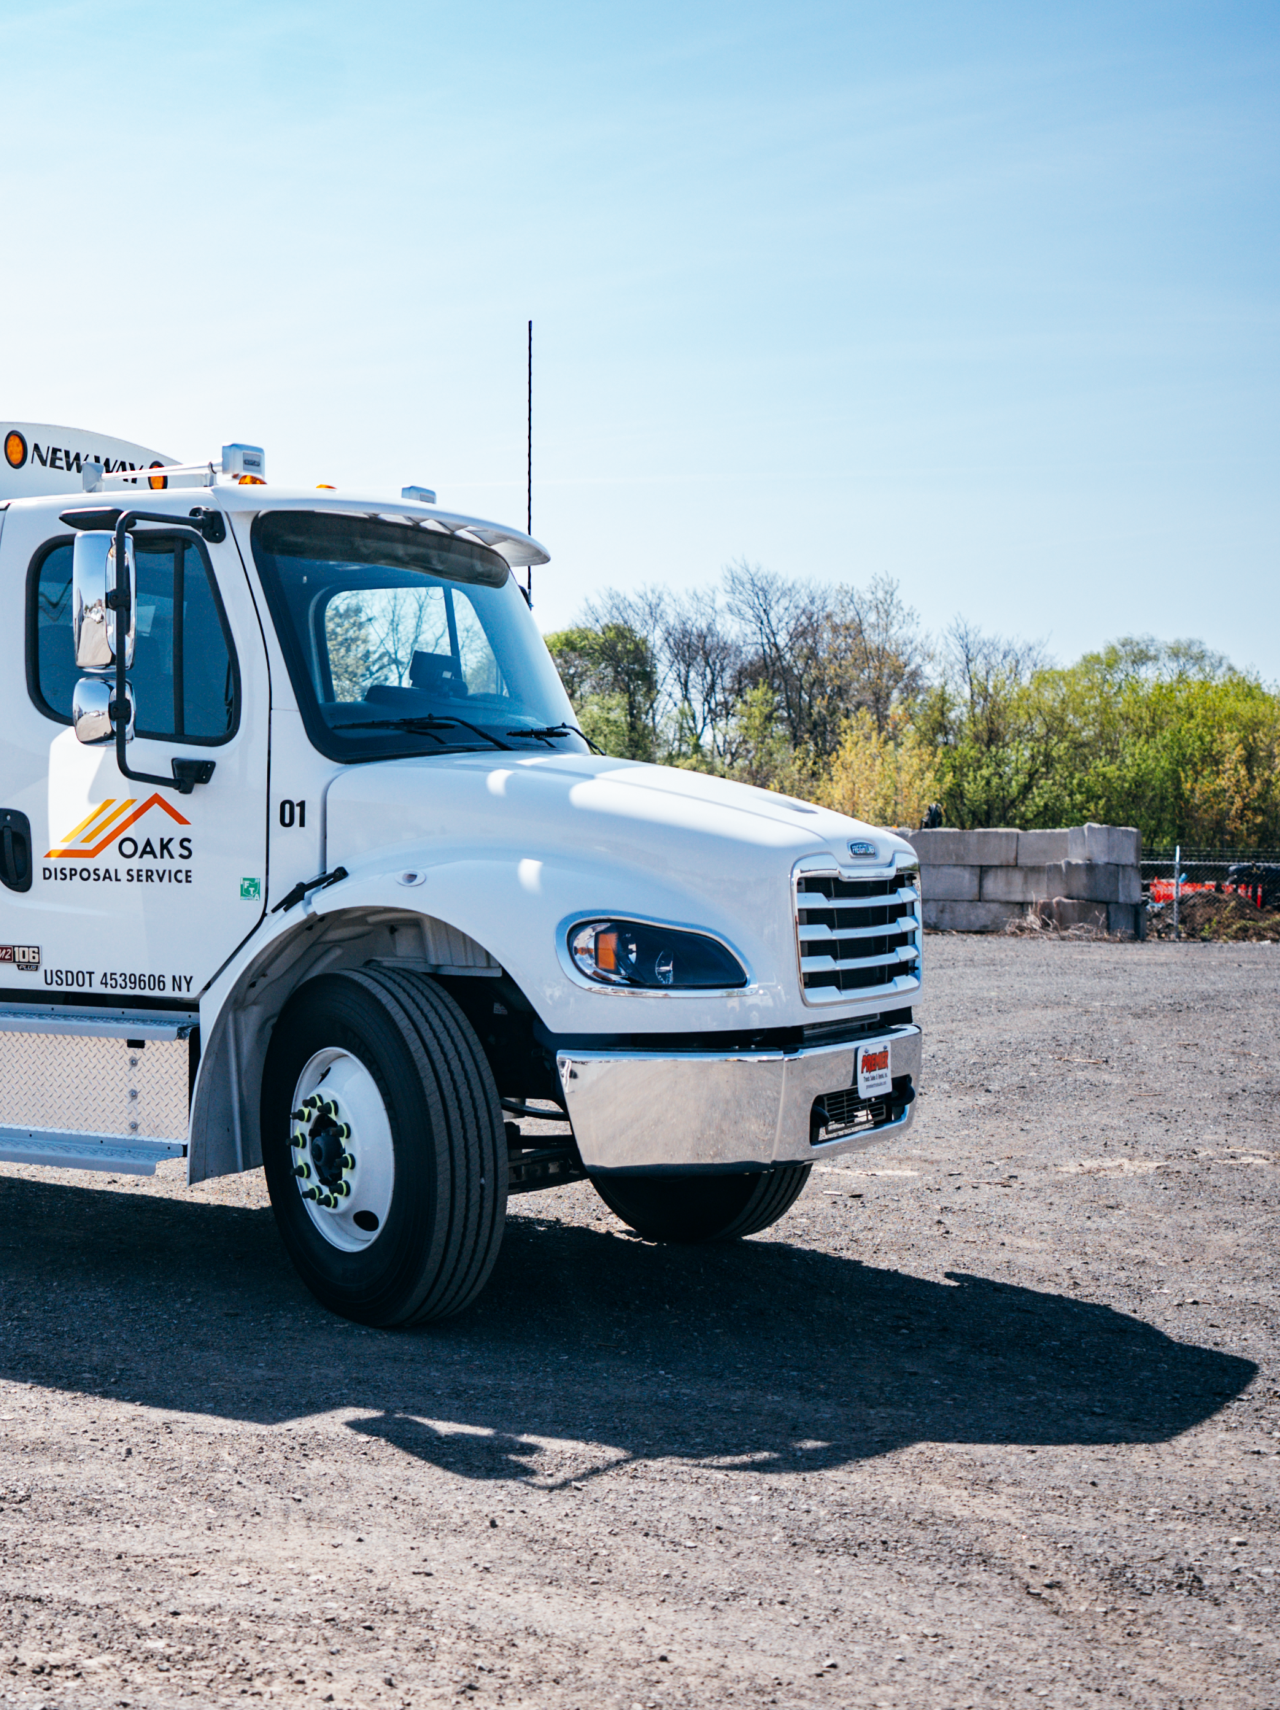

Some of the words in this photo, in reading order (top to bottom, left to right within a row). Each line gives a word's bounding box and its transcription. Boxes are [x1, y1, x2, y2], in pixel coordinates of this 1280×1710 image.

[31, 443, 89, 473] NEW
[279, 799, 306, 828] 01
[118, 837, 193, 860] OAKS
[42, 867, 122, 882] DISPOSAL
[126, 868, 193, 884] SERVICE
[14, 946, 39, 963] 106
[44, 969, 95, 988] USDOT
[100, 972, 166, 992] 4539606
[172, 975, 193, 992] NY
[861, 1050, 889, 1074] PREMIER
